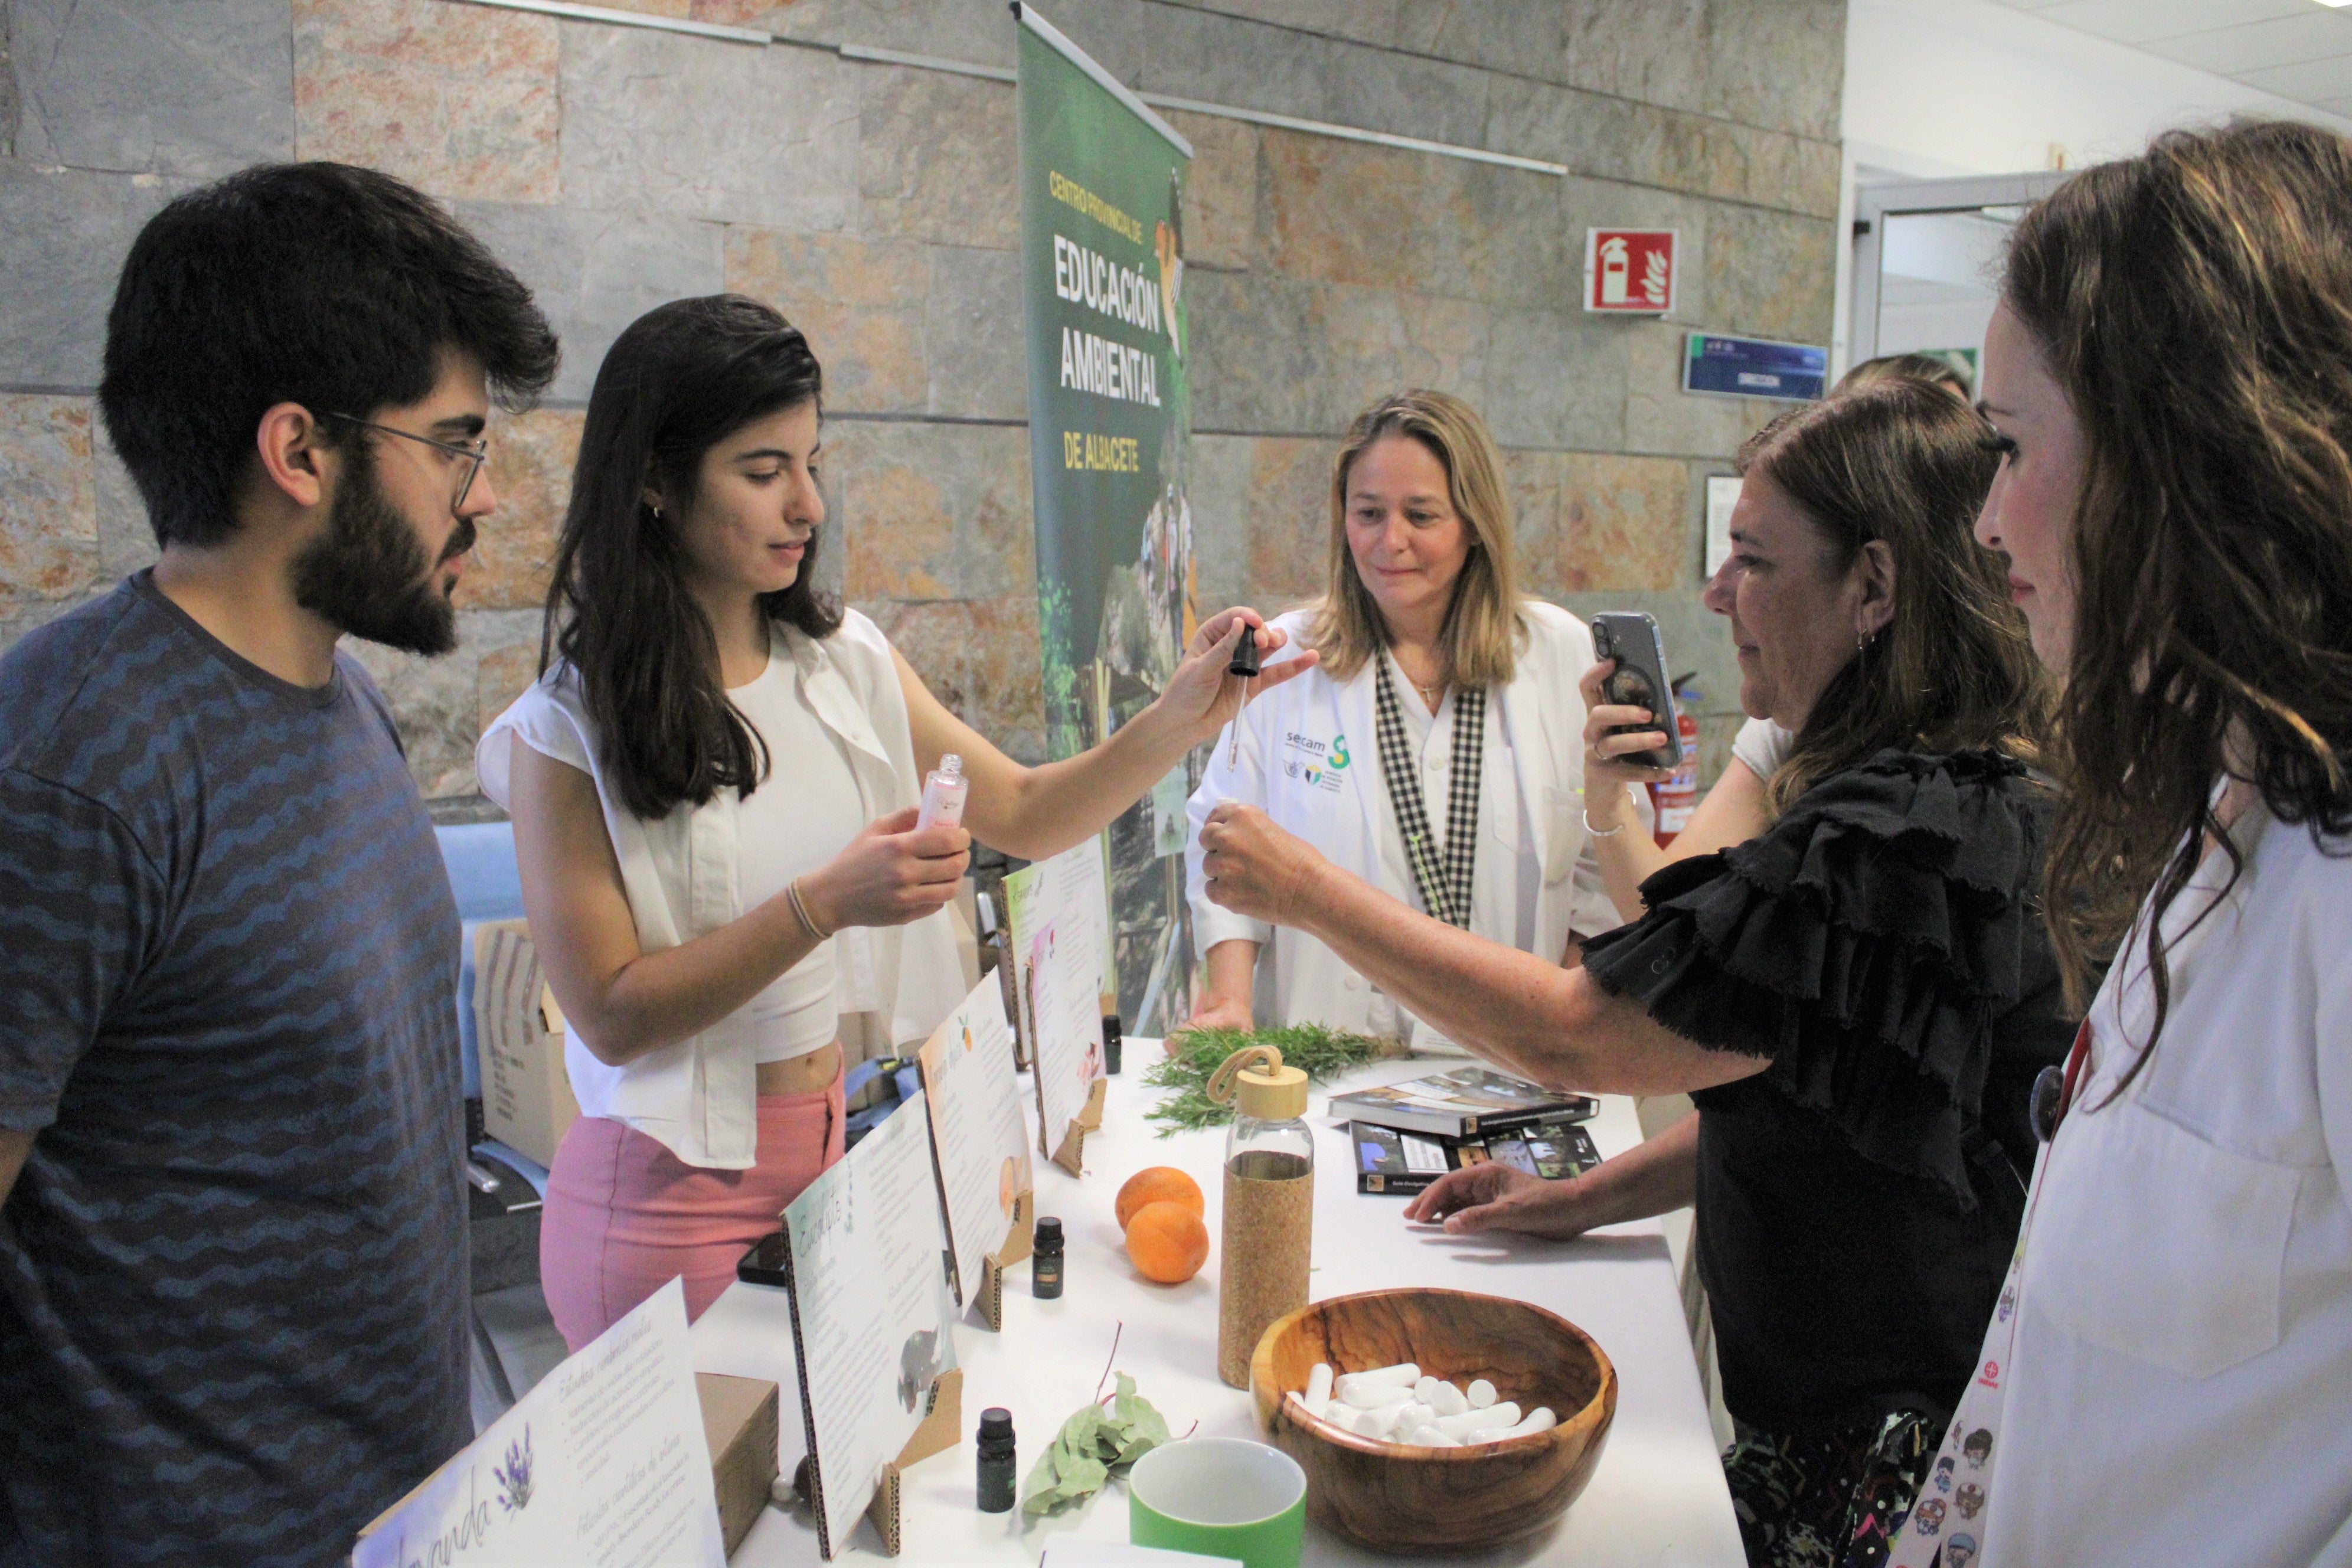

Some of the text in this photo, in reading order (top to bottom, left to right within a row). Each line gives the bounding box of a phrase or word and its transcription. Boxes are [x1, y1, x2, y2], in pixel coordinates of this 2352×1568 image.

[1050, 169, 1087, 213] CENTRO
[1054, 234, 1160, 334] EDUCACIÓN
[1060, 326, 1161, 408] AMBIENTAL
[1064, 431, 1139, 473] DE ALBACETE
[1286, 731, 1326, 752] secam
